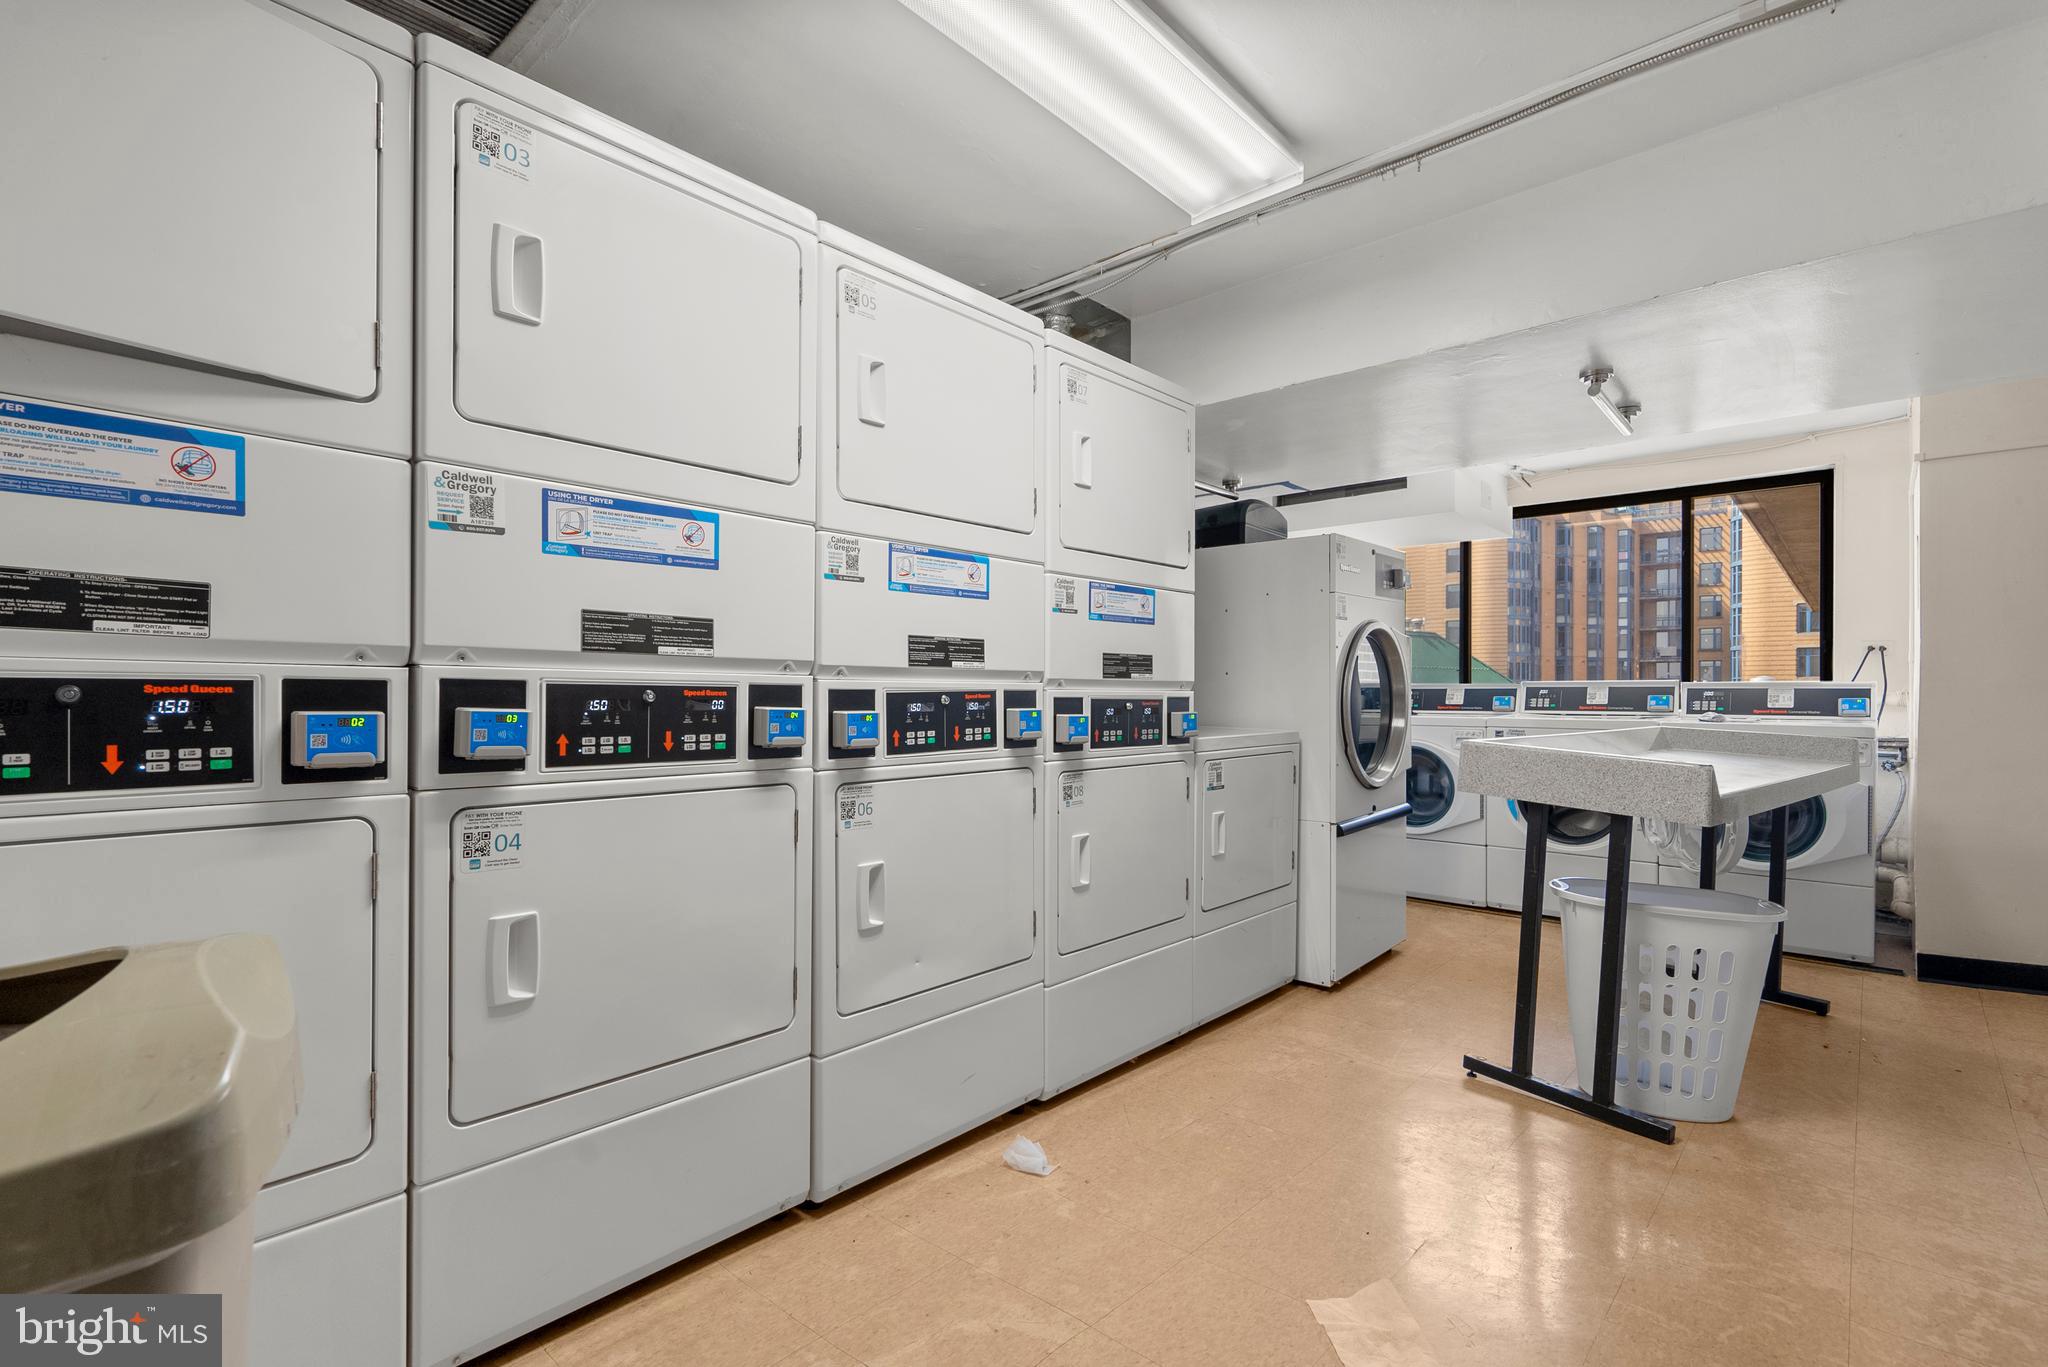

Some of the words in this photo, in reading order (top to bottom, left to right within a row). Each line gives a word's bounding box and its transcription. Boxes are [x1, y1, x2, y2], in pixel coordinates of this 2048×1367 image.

[486, 110, 498, 119] WITH
[500, 116, 513, 126] YOUR
[514, 123, 532, 134] PHONE
[504, 143, 530, 167] 03
[861, 293, 877, 310] 05
[1077, 384, 1088, 396] 07
[47, 427, 91, 438] OVERLOAD
[92, 433, 107, 441] THE
[107, 436, 133, 444] DRYER
[45, 433, 64, 441] WILL
[65, 436, 99, 446] DAMAGE
[100, 441, 123, 449] YOUR
[124, 444, 159, 454] LAUNDRY
[3, 451, 25, 459] TRAP
[441, 469, 493, 485] Caldwell
[434, 476, 446, 488] &
[447, 480, 497, 497] Gregory
[436, 490, 464, 498] REQUEST
[548, 490, 572, 499] USING
[573, 494, 588, 502] THE
[589, 496, 614, 505] DRYER
[154, 496, 237, 511] caldwellandgregory.com
[831, 535, 859, 546] Caldwell
[833, 543, 861, 554] Gregory
[143, 684, 189, 695] Speed
[190, 684, 234, 693] Queen
[683, 689, 706, 697] Speed
[706, 689, 728, 697] Queen
[711, 700, 725, 710] 00
[350, 717, 366, 727] 02
[506, 714, 518, 723] 03
[1073, 785, 1084, 797] 08
[857, 801, 873, 816] 06
[494, 832, 522, 853] 04
